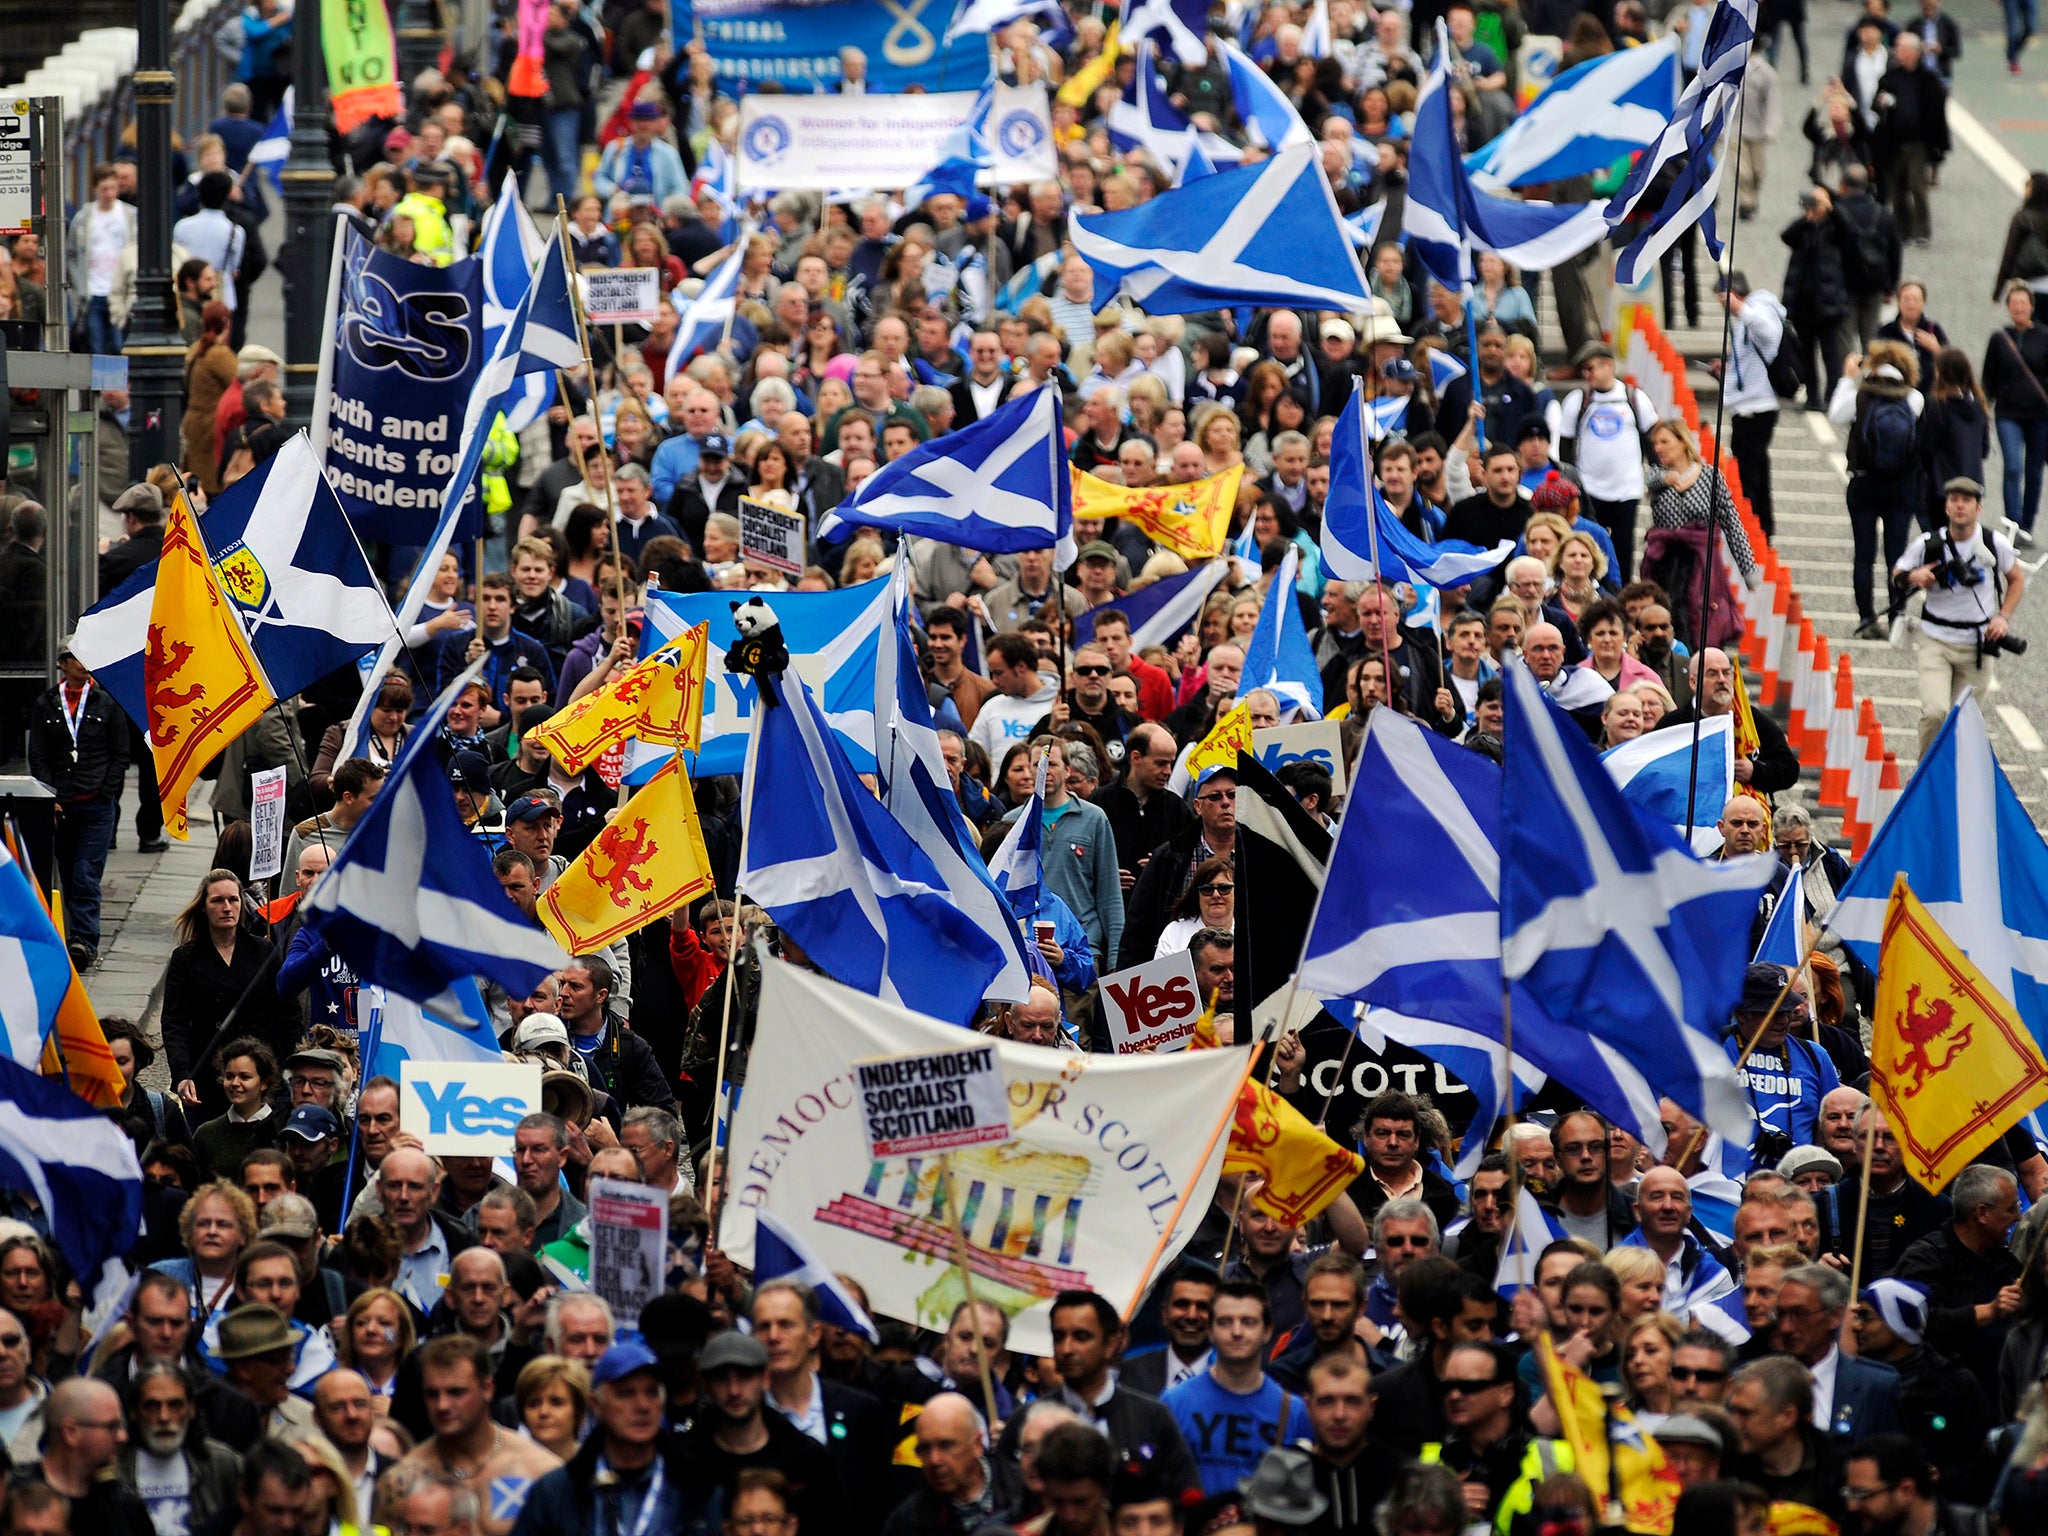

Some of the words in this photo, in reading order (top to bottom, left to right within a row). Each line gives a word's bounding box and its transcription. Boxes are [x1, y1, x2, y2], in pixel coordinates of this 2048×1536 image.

[0, 141, 23, 151] idge
[0, 153, 13, 163] op
[330, 391, 373, 432] outh
[381, 414, 449, 442] and
[328, 426, 406, 474] dents
[1104, 975, 1196, 1035] Yes
[1119, 1020, 1198, 1055] Aberdeenshir
[859, 1049, 992, 1089] INDEPENDENT
[1746, 1052, 1784, 1071] HOOS
[864, 1079, 967, 1116] SOCIALIST
[1738, 1067, 1803, 1097] REEDOM
[410, 1081, 529, 1137] Yes
[869, 1104, 976, 1142] SCOTLAND
[739, 1073, 856, 1209] DEMOC
[1007, 1080, 1067, 1121] OR
[1192, 1411, 1279, 1457] YES
